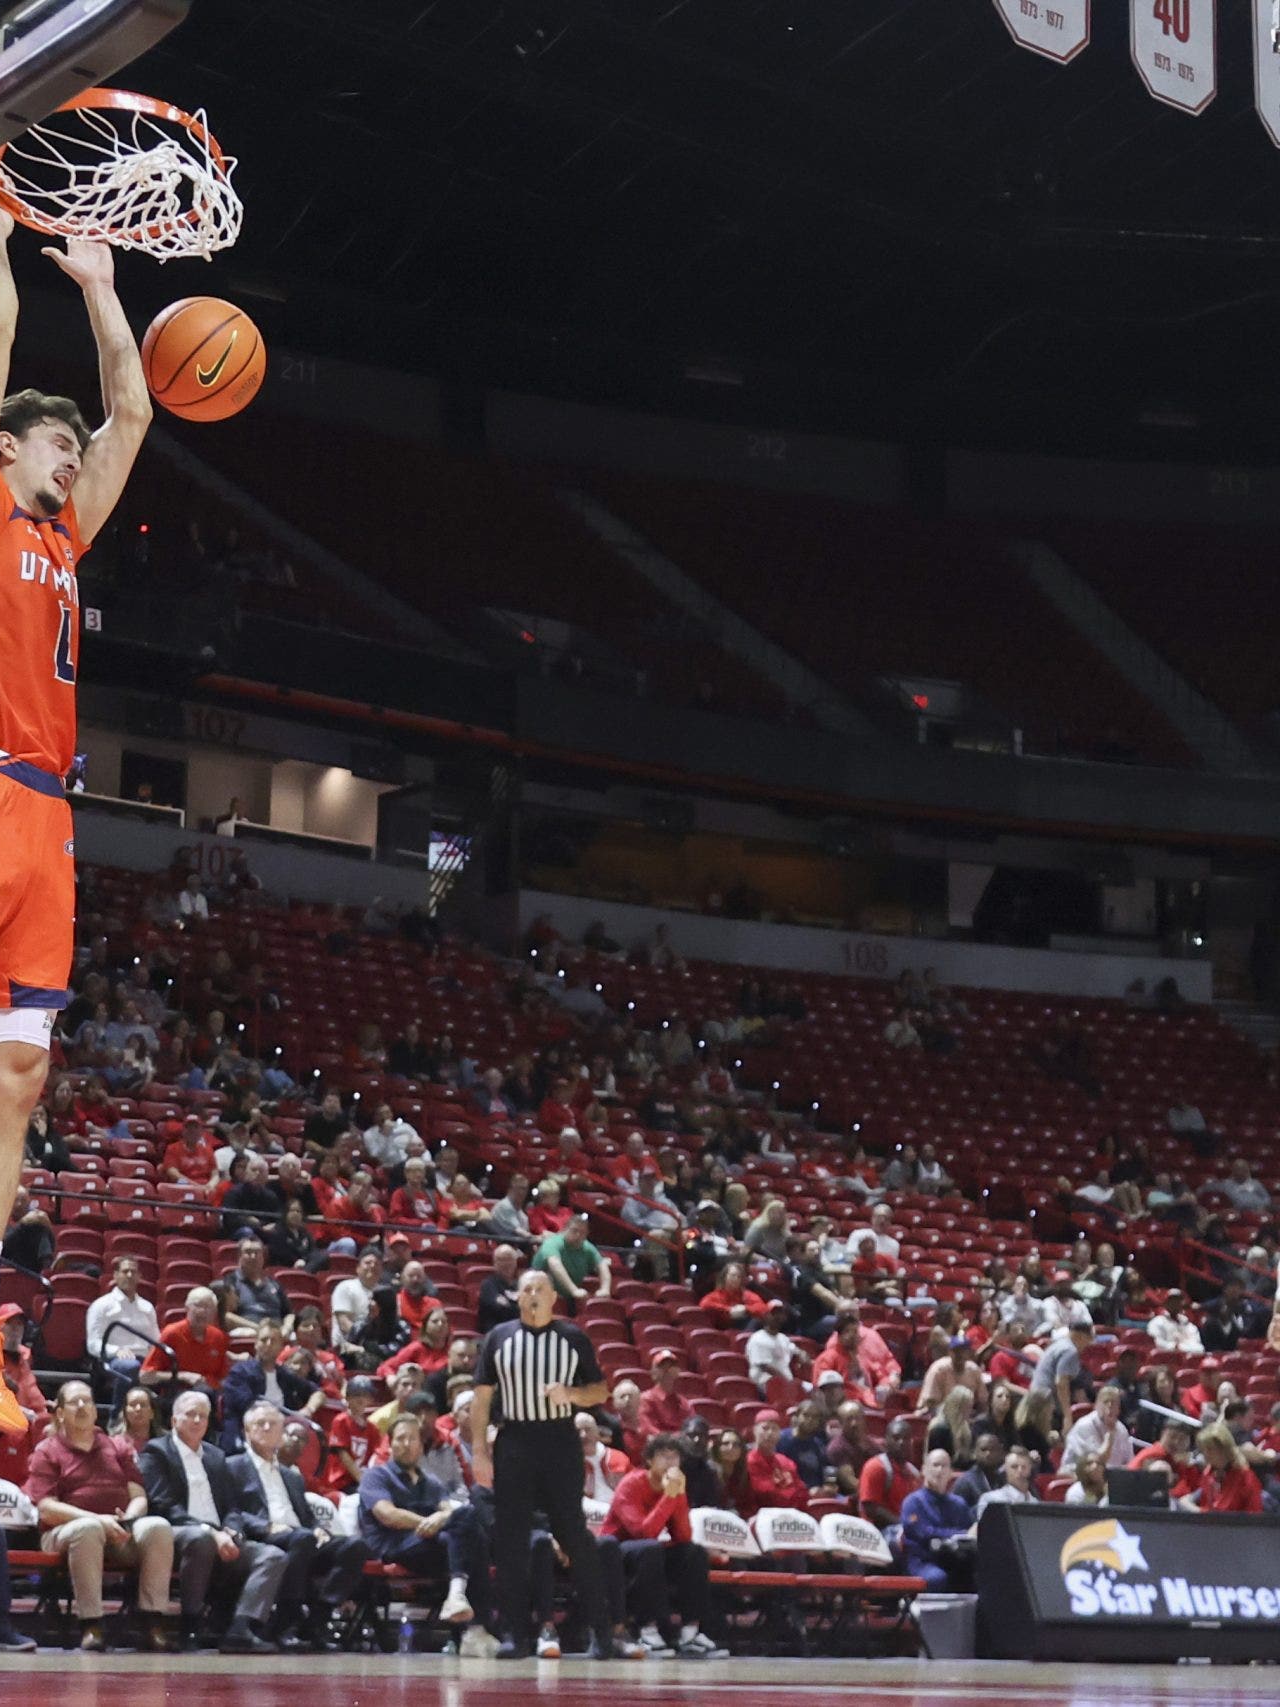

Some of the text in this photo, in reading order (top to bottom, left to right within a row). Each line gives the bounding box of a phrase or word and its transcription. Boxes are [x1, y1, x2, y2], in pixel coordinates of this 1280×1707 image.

[1153, 0, 1190, 43] 40
[1154, 52, 1172, 73] 1973
[1178, 64, 1195, 82] 1975
[280, 354, 317, 384] 211
[87, 612, 99, 629] 3
[1065, 1569, 1158, 1616] Star
